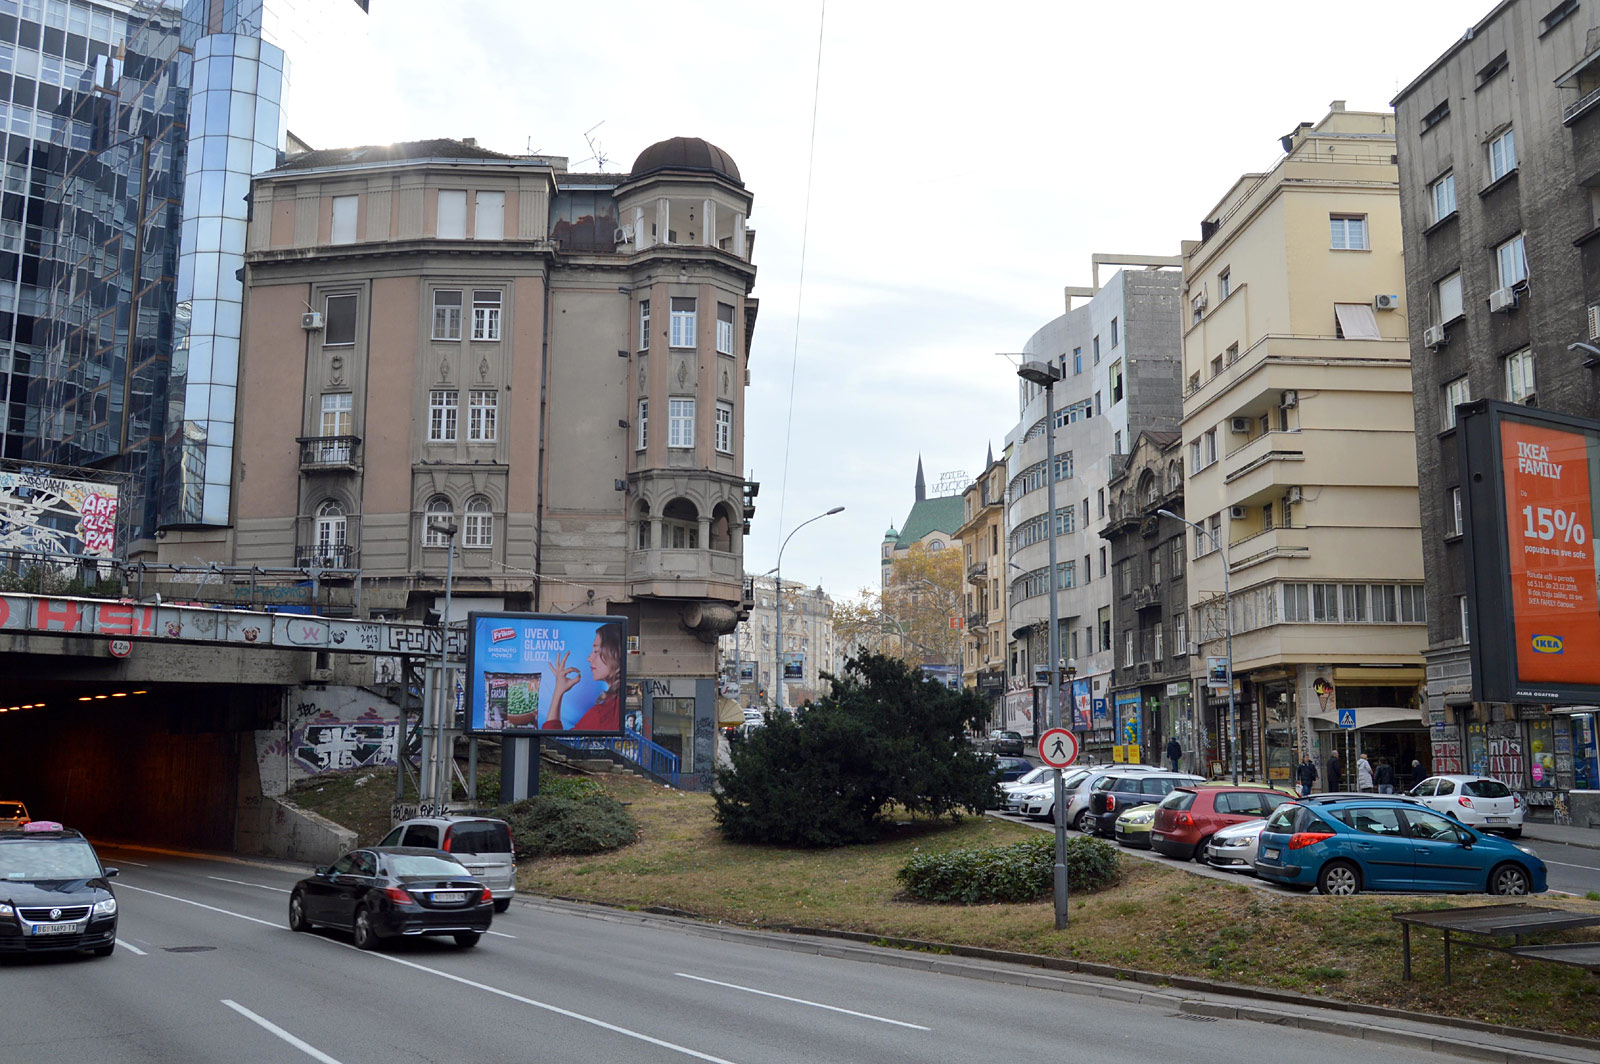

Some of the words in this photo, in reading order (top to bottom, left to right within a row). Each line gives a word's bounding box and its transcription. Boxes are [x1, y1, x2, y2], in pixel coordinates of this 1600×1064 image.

[1517, 441, 1549, 462] IKEA
[1518, 458, 1563, 480] FAMILY
[1522, 505, 1585, 545] 15%
[1524, 545, 1550, 555] popusta
[1573, 551, 1587, 560] sofe
[1528, 598, 1540, 606] IKEA
[1540, 599, 1556, 607] FAMILY
[525, 628, 549, 639] UVEK
[552, 629, 559, 639] U
[524, 640, 565, 650] GLAVNOJ
[1536, 639, 1560, 649] IKEA
[1095, 701, 1103, 710] P
[37, 925, 47, 933] BG
[68, 923, 76, 931] TX
